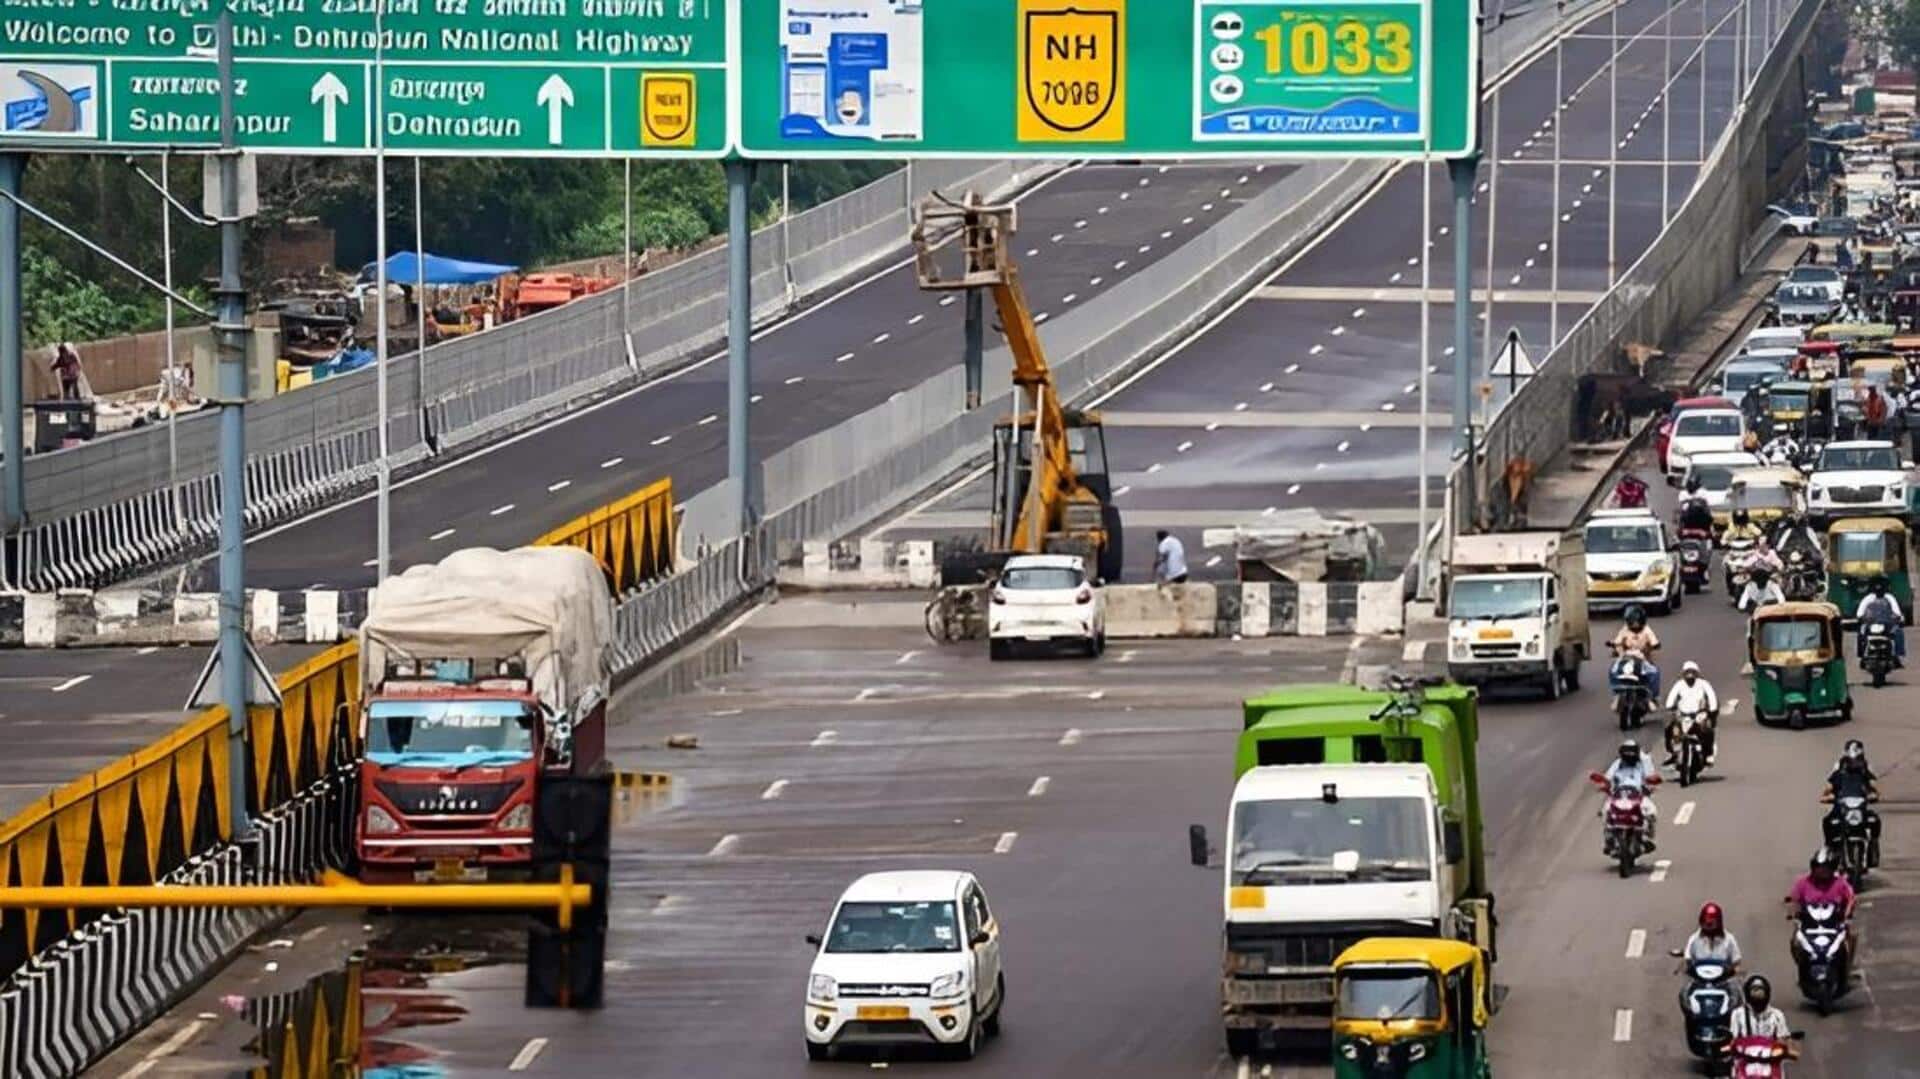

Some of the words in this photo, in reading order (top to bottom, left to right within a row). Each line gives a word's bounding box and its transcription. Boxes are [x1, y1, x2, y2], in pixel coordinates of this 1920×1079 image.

[4, 20, 131, 46] Welcome
[149, 25, 176, 46] to
[193, 23, 266, 47] Dlhi
[441, 28, 559, 51] National
[575, 29, 693, 56] Highway
[1046, 34, 1097, 60] NH
[1254, 22, 1414, 75] 1033
